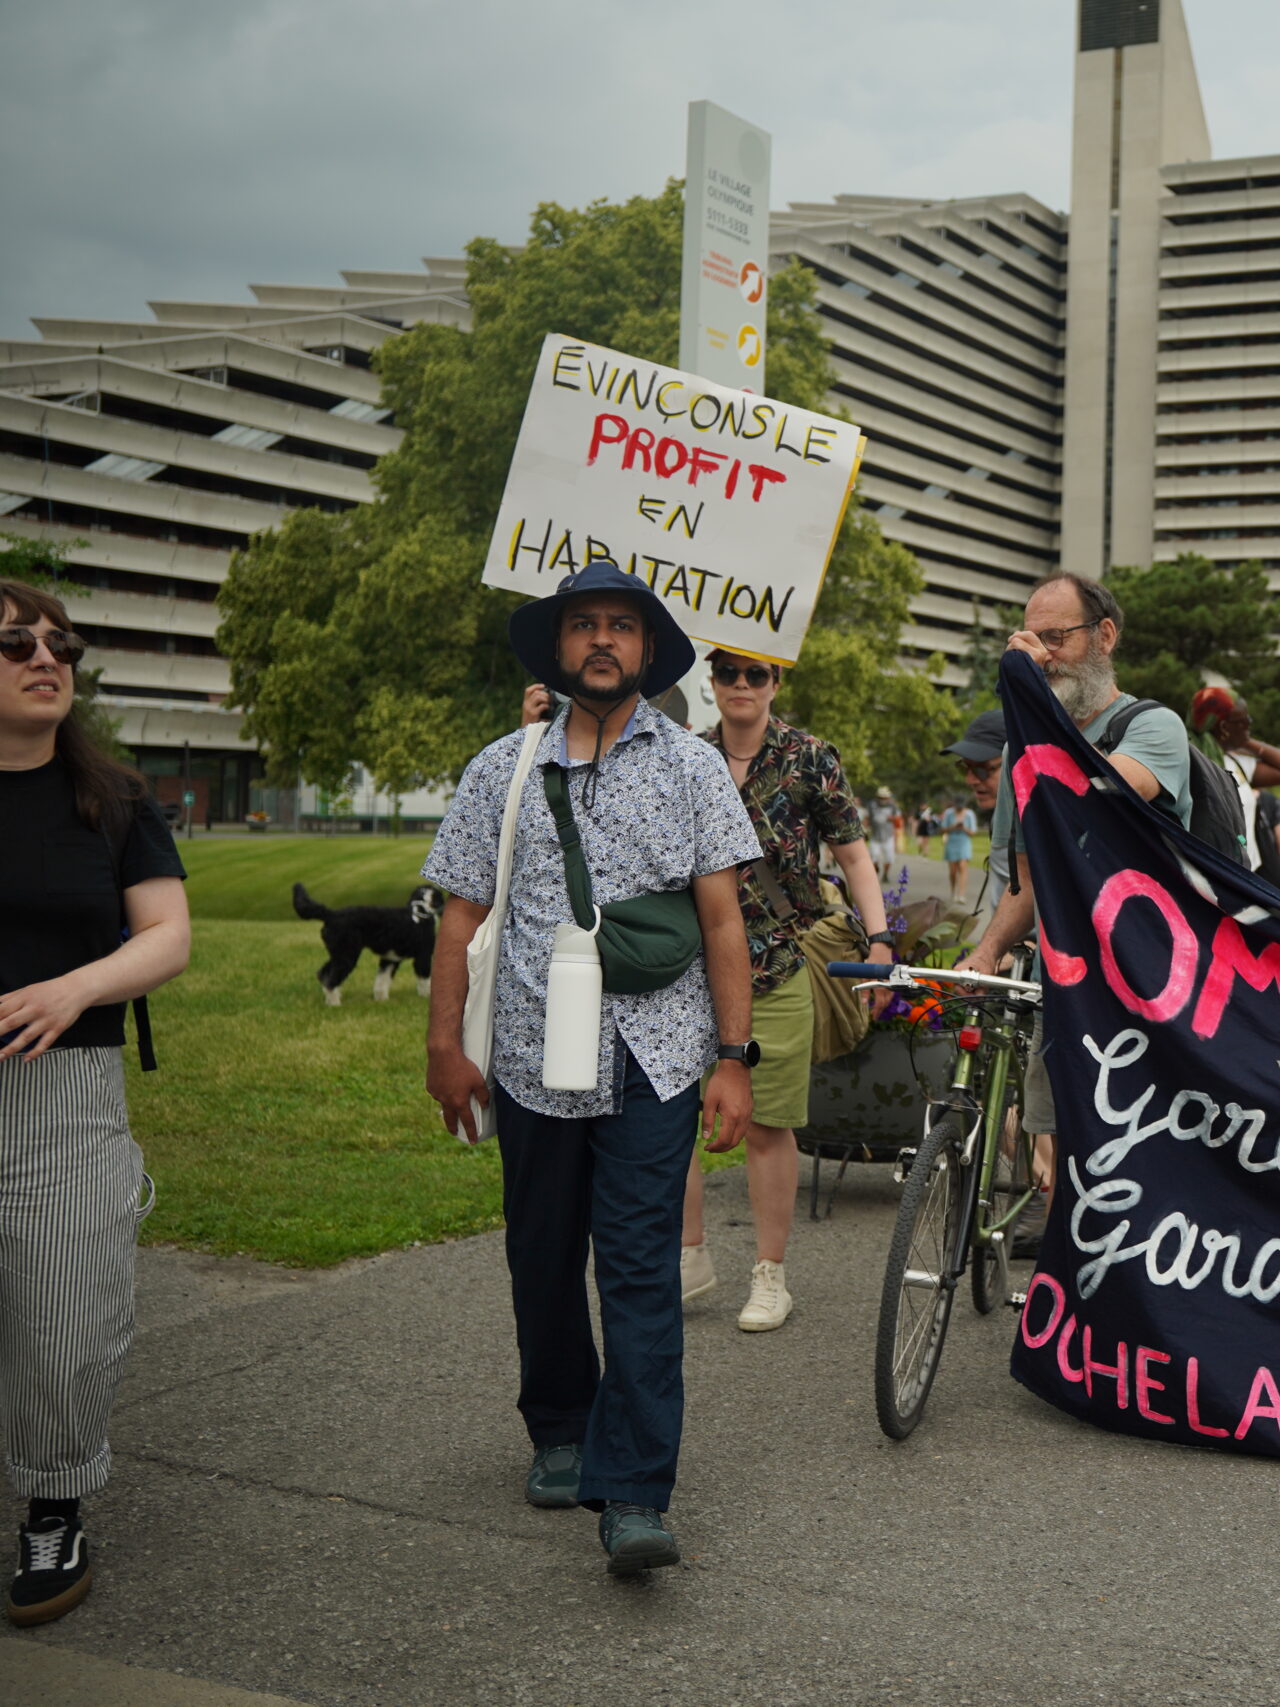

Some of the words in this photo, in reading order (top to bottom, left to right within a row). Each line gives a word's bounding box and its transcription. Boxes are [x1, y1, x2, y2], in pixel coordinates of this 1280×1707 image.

[707, 185, 754, 216] OLYMPIQUE
[719, 173, 752, 198] VILLAGE
[587, 413, 787, 503] PROFIT
[636, 494, 705, 539] EN
